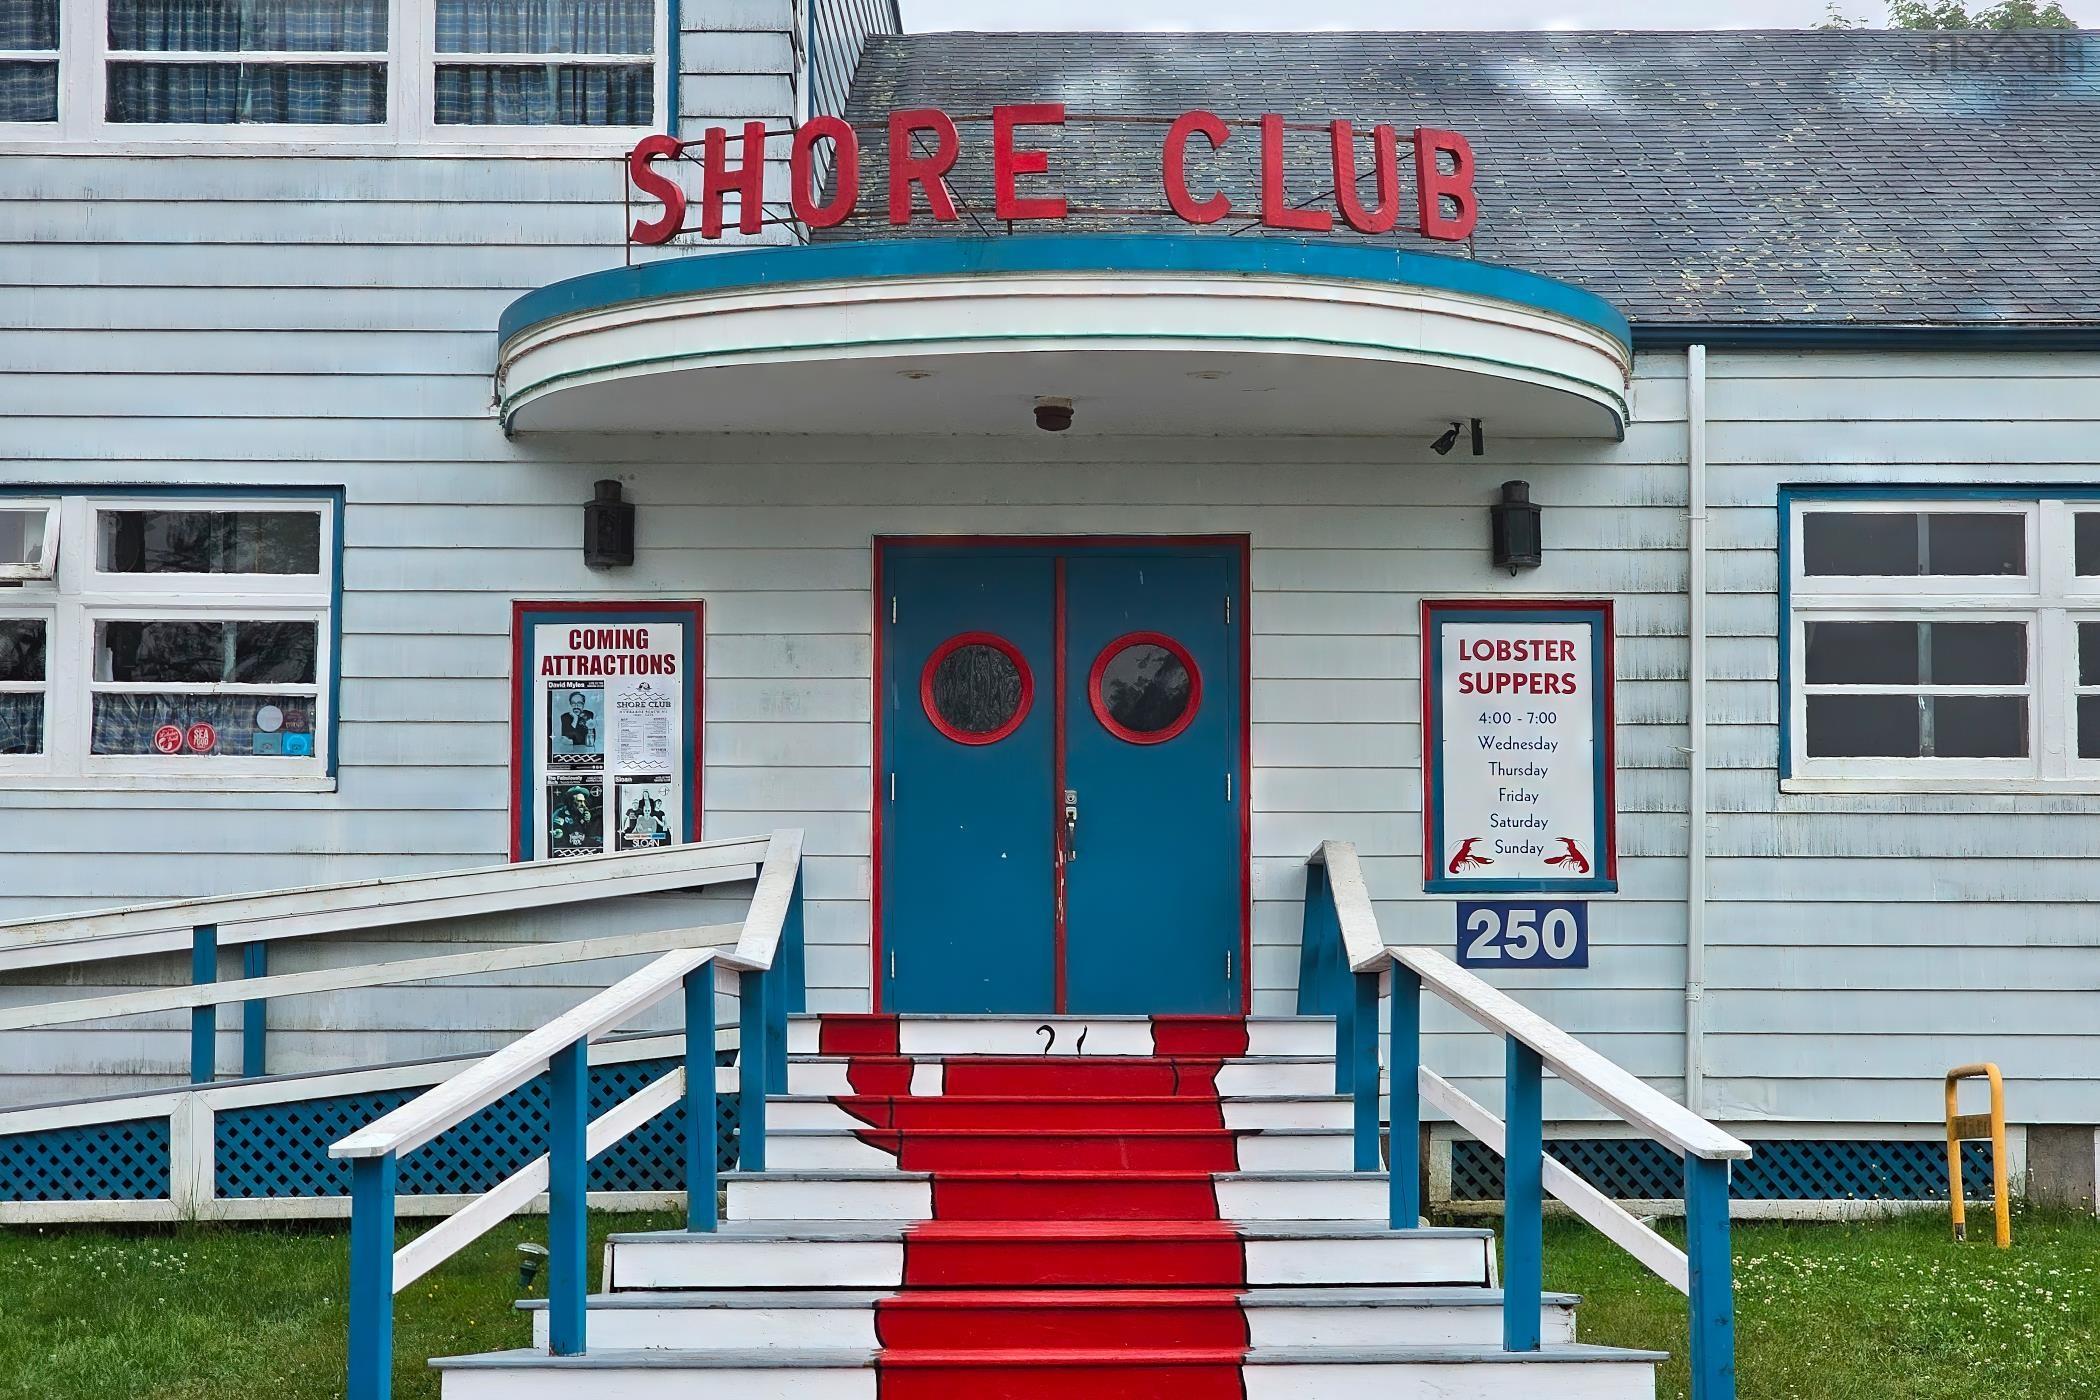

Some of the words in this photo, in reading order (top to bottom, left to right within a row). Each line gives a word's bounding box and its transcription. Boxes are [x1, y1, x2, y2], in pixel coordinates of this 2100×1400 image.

[630, 103, 1067, 246] SHORE
[1162, 110, 1478, 241] CLUB
[569, 628, 649, 650] COMING
[1458, 639, 1577, 662] LOBSTER
[541, 653, 676, 676] ATTRACTIONS
[1458, 671, 1577, 695] SUPPERS
[1478, 711, 1511, 725] 4:00
[1527, 711, 1557, 725] 7:00
[193, 729, 209, 739] SEA
[1477, 735, 1559, 752] Wednesday
[1488, 761, 1548, 779] Thursday
[1498, 788, 1539, 805] Friday
[1490, 813, 1549, 831] Saturday
[632, 839, 660, 848] SLOAN
[1494, 839, 1545, 857] Sunday
[1466, 908, 1578, 960] 250
